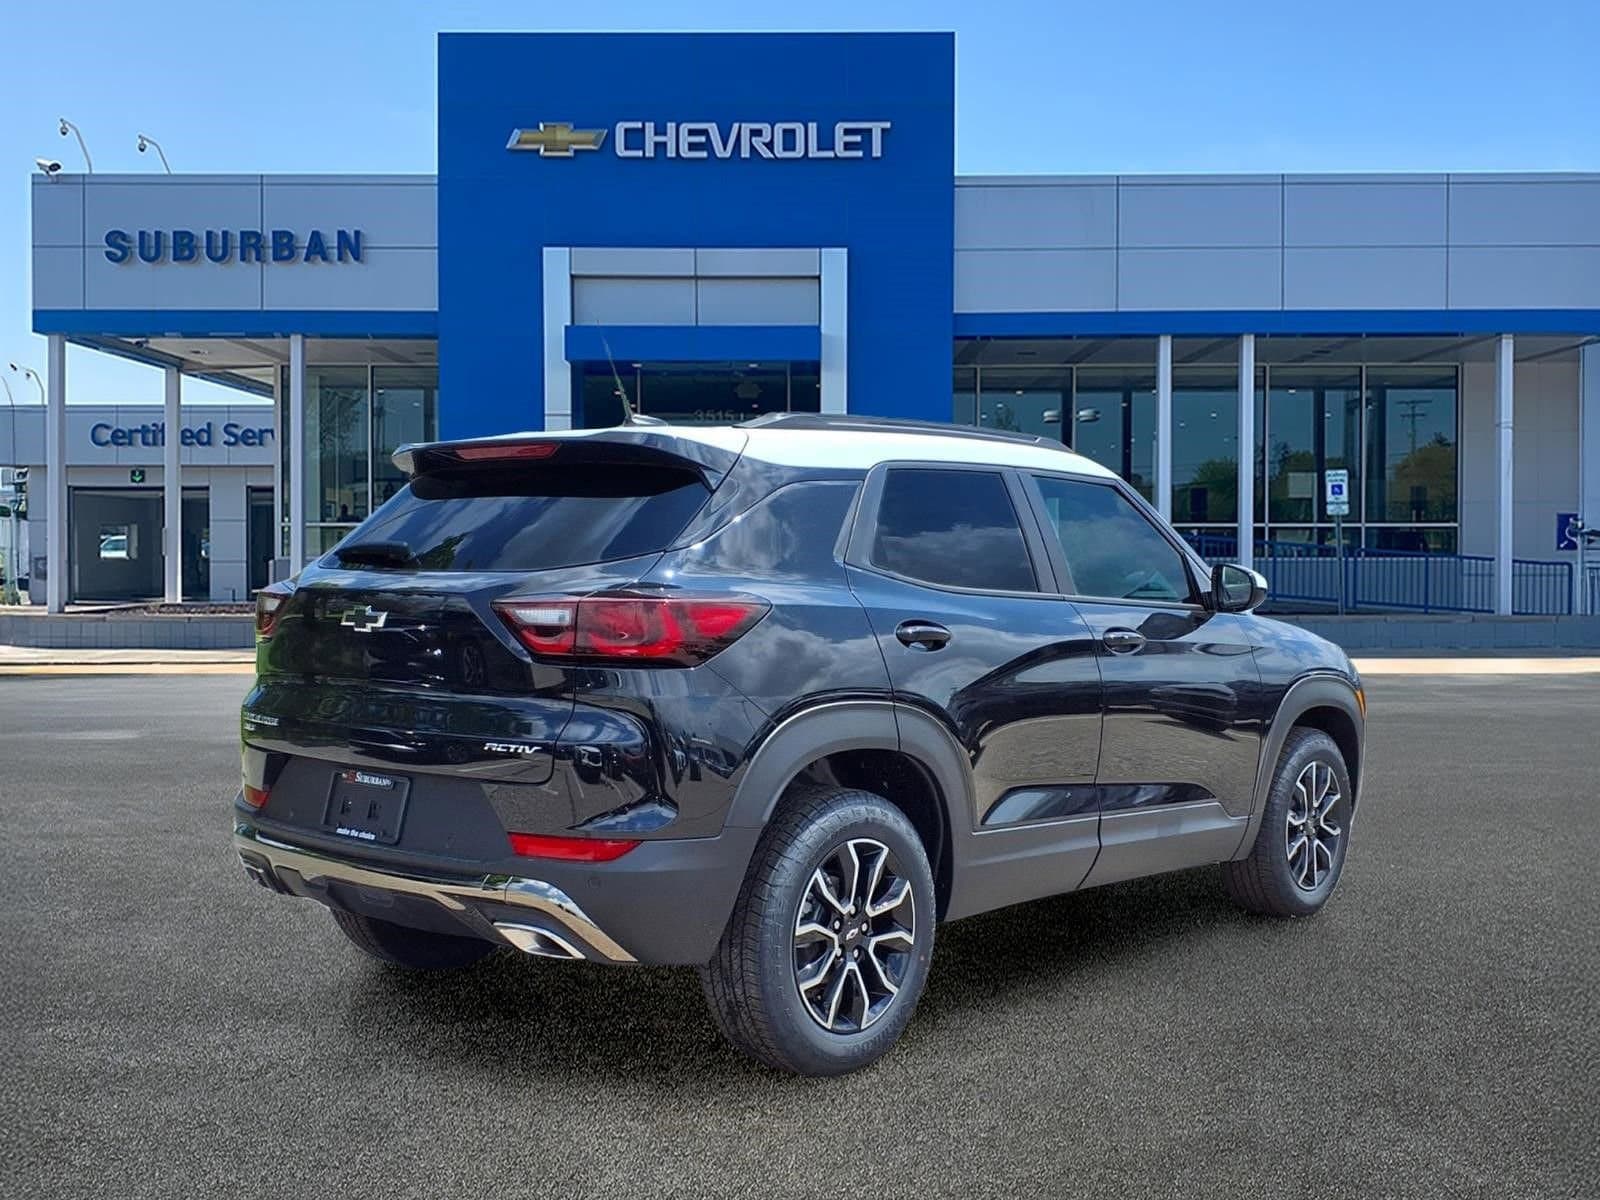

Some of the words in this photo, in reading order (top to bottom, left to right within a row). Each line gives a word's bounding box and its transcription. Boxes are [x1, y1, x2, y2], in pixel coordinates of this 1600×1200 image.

[614, 120, 892, 160] CHEVROLET
[104, 229, 363, 264] SUBURBAN
[90, 422, 213, 448] Certifed
[483, 742, 542, 754] ACTIV
